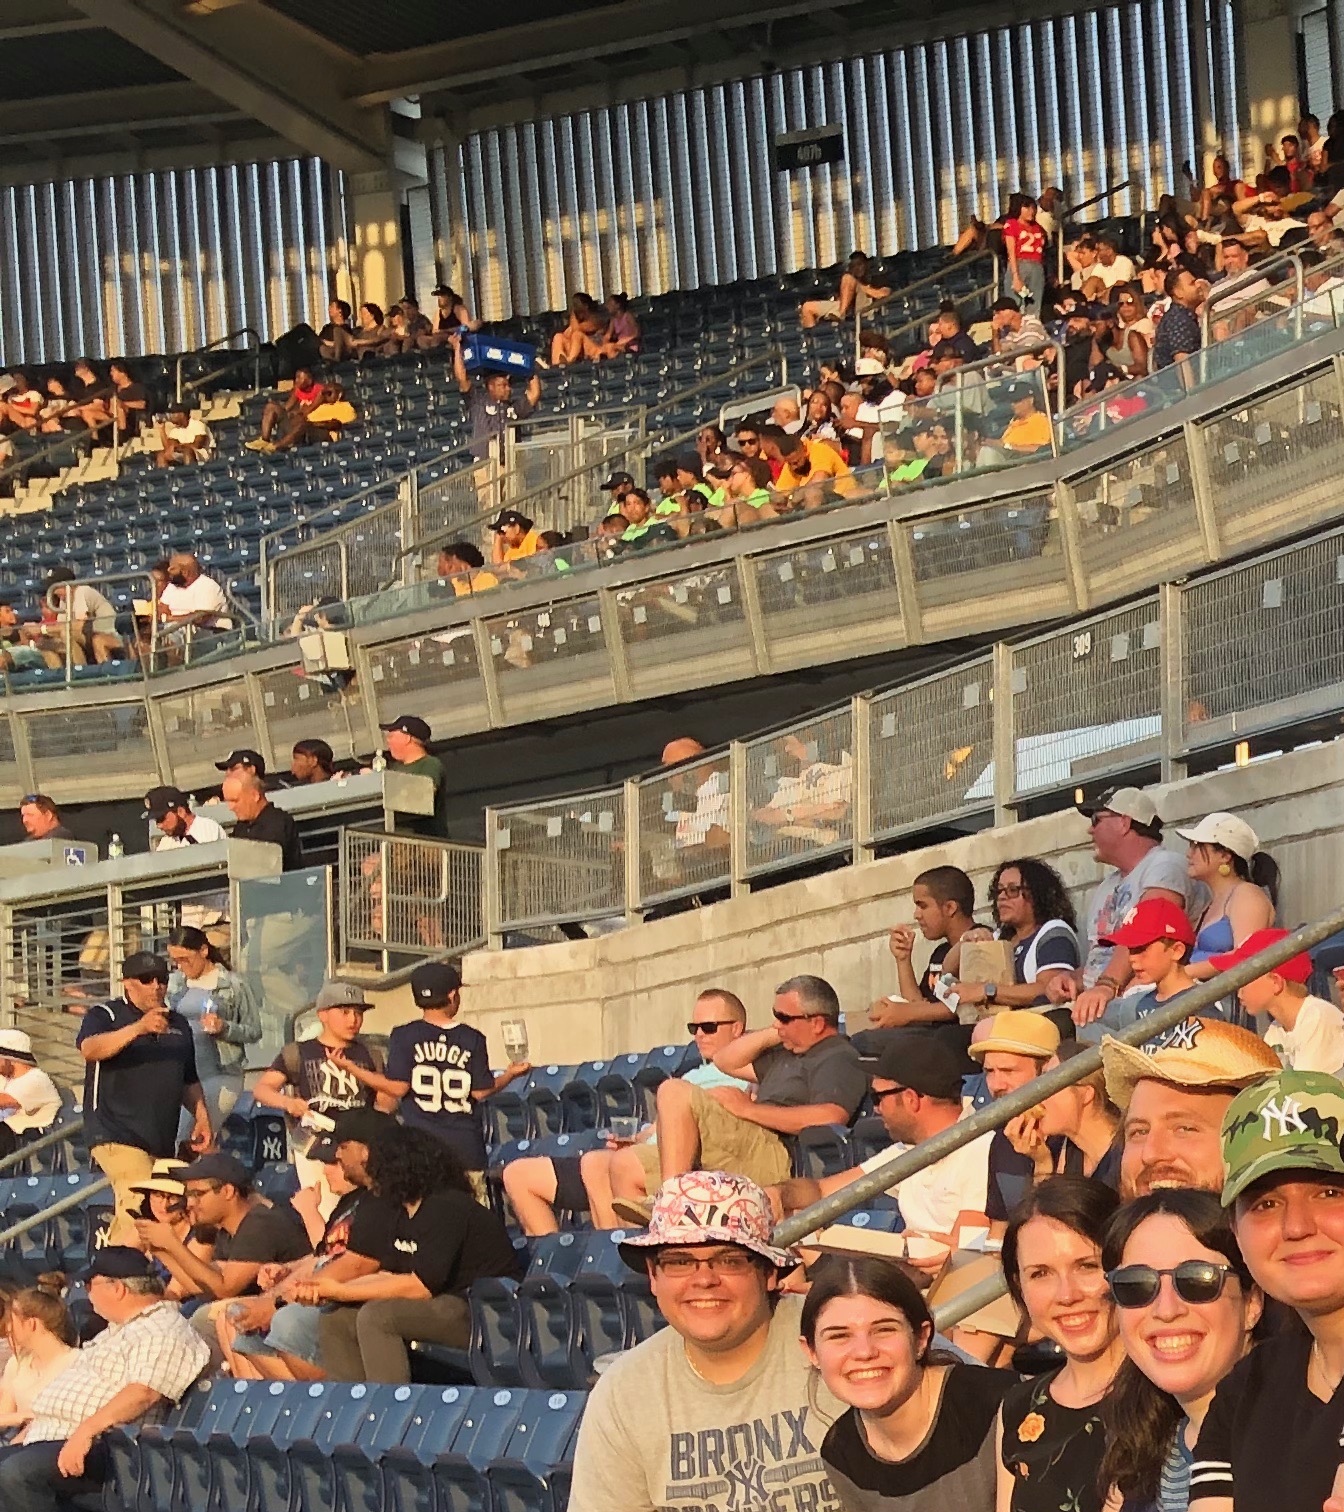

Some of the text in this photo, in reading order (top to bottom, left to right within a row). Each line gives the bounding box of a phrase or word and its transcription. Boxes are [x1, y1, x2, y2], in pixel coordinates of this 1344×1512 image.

[1073, 631, 1091, 659] 309
[1161, 1018, 1203, 1051] NY
[414, 1042, 473, 1070] JUDGE
[320, 1059, 360, 1099] NY
[411, 1064, 473, 1114] 99
[1260, 1095, 1308, 1141] NY
[262, 1136, 282, 1160] NY
[670, 1406, 818, 1481] BRONX
[724, 1459, 770, 1509] NY
